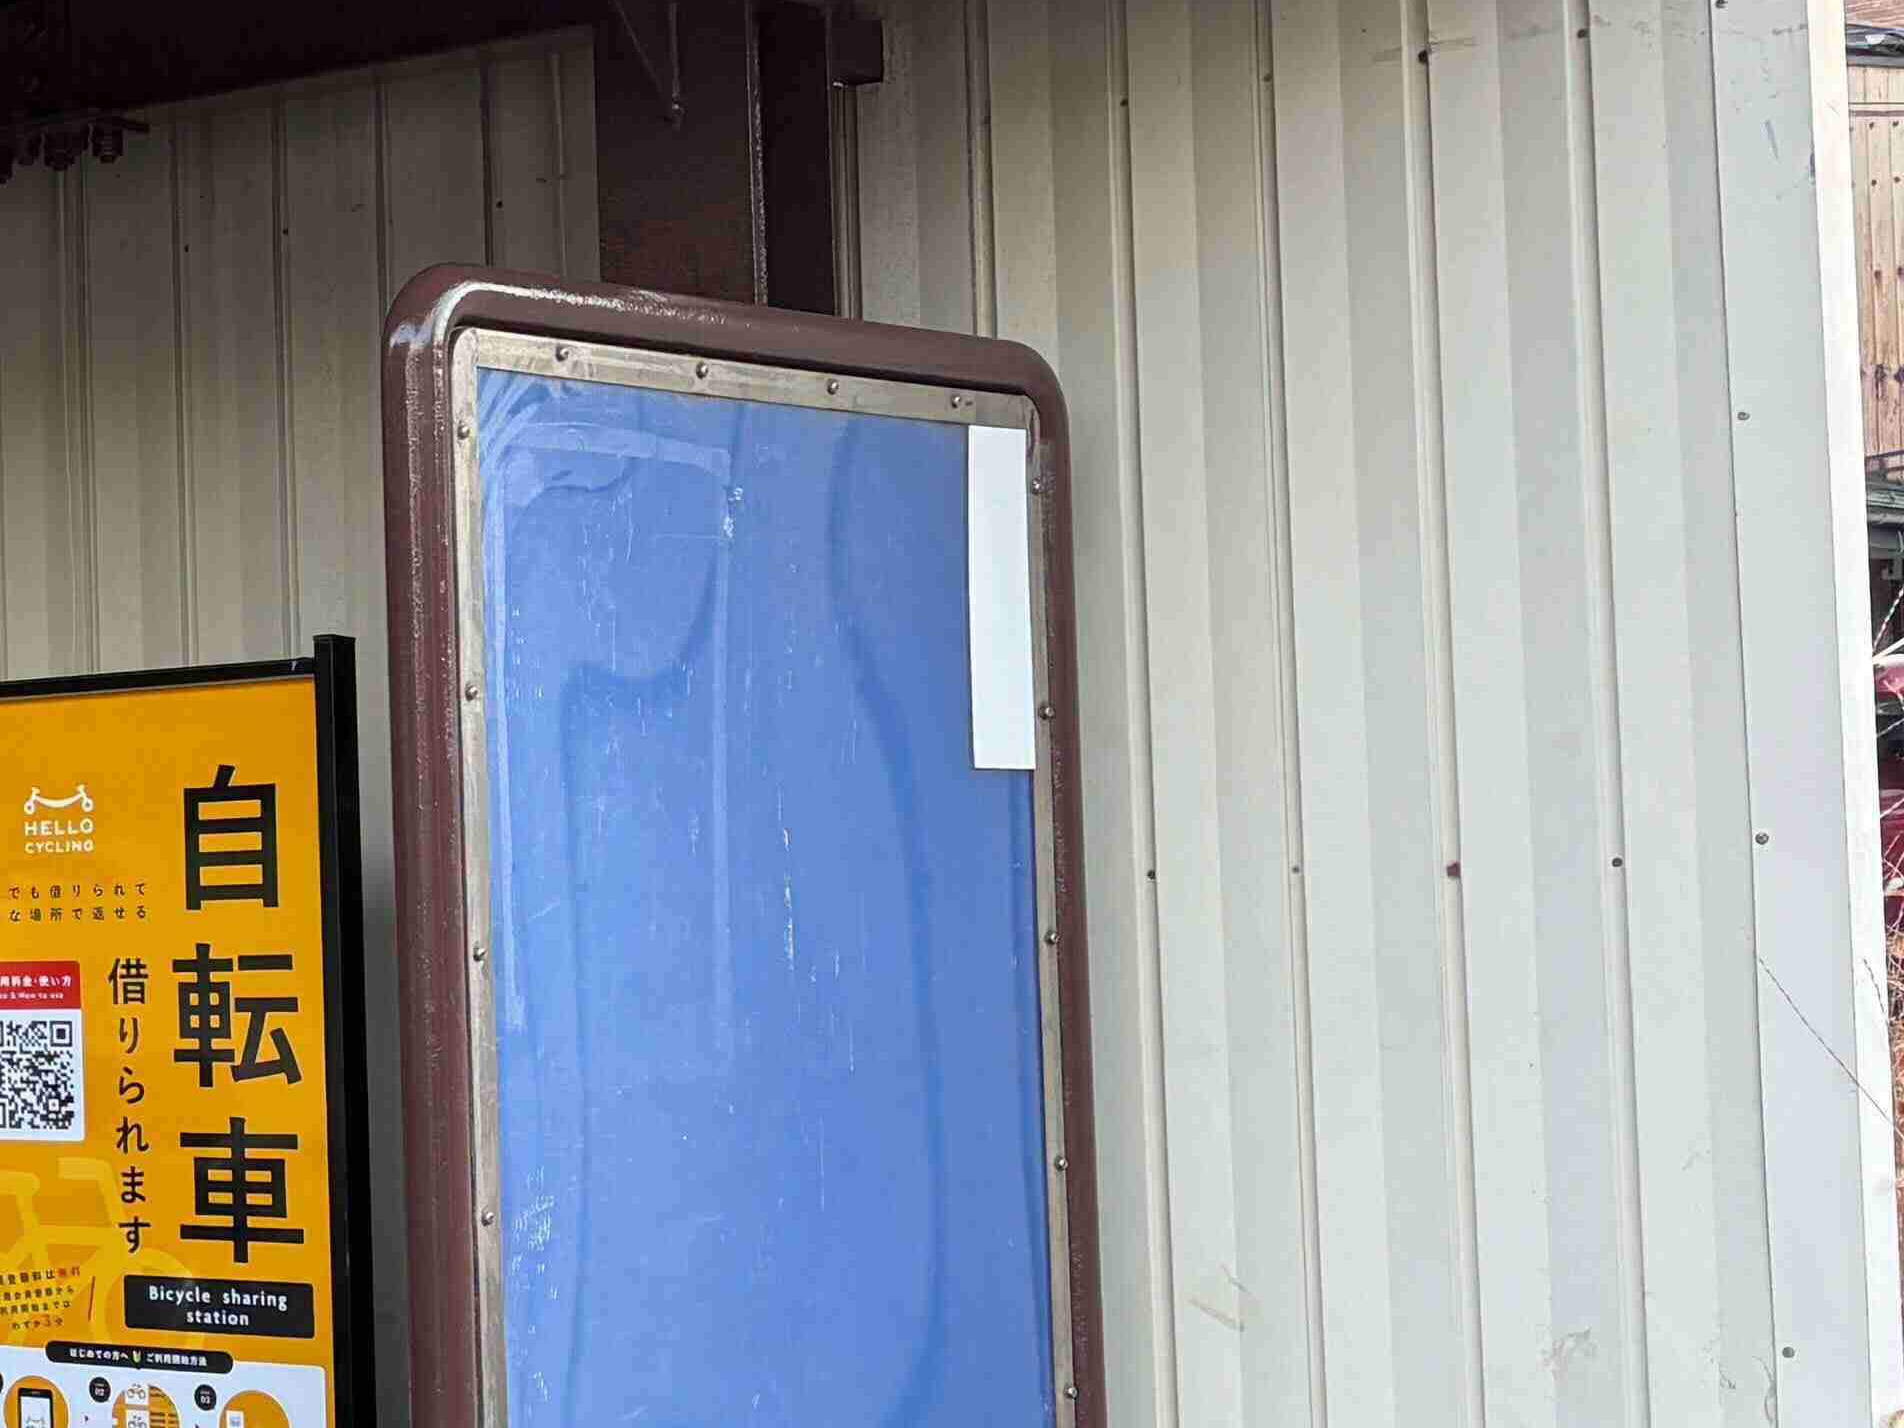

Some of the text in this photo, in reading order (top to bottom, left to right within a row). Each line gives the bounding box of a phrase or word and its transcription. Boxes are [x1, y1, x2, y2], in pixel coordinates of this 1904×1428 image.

[24, 818, 94, 836] HELLO
[25, 840, 94, 853] CYCLING
[172, 764, 304, 1263] 自転車
[107, 957, 151, 1254] 借りられます
[149, 1285, 287, 1311] Bicycle sharing
[187, 1310, 249, 1326] station
